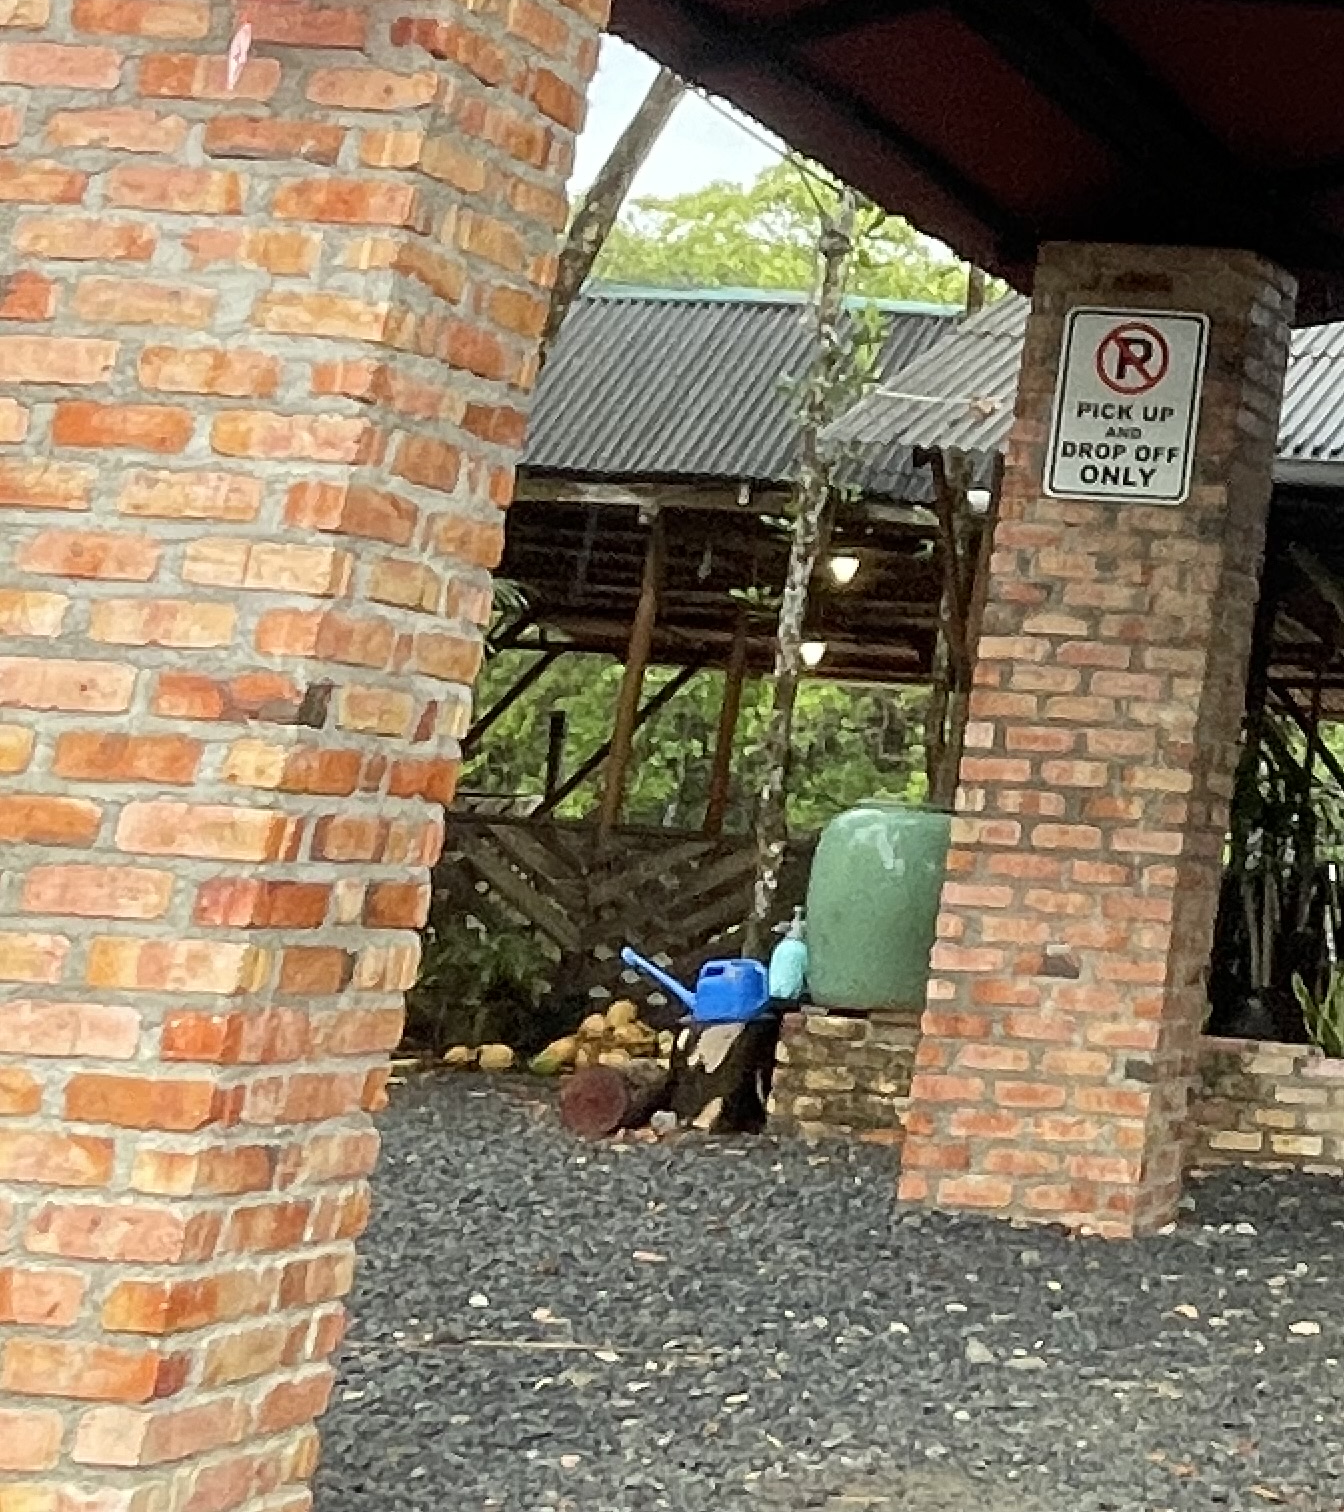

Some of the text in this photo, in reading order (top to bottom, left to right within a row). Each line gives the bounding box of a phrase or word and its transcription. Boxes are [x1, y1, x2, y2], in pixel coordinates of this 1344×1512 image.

[1076, 400, 1175, 422] PICK UP
[1105, 426, 1142, 439] AND
[1061, 440, 1181, 464] DROP OFF
[1079, 464, 1158, 487] ONLY
